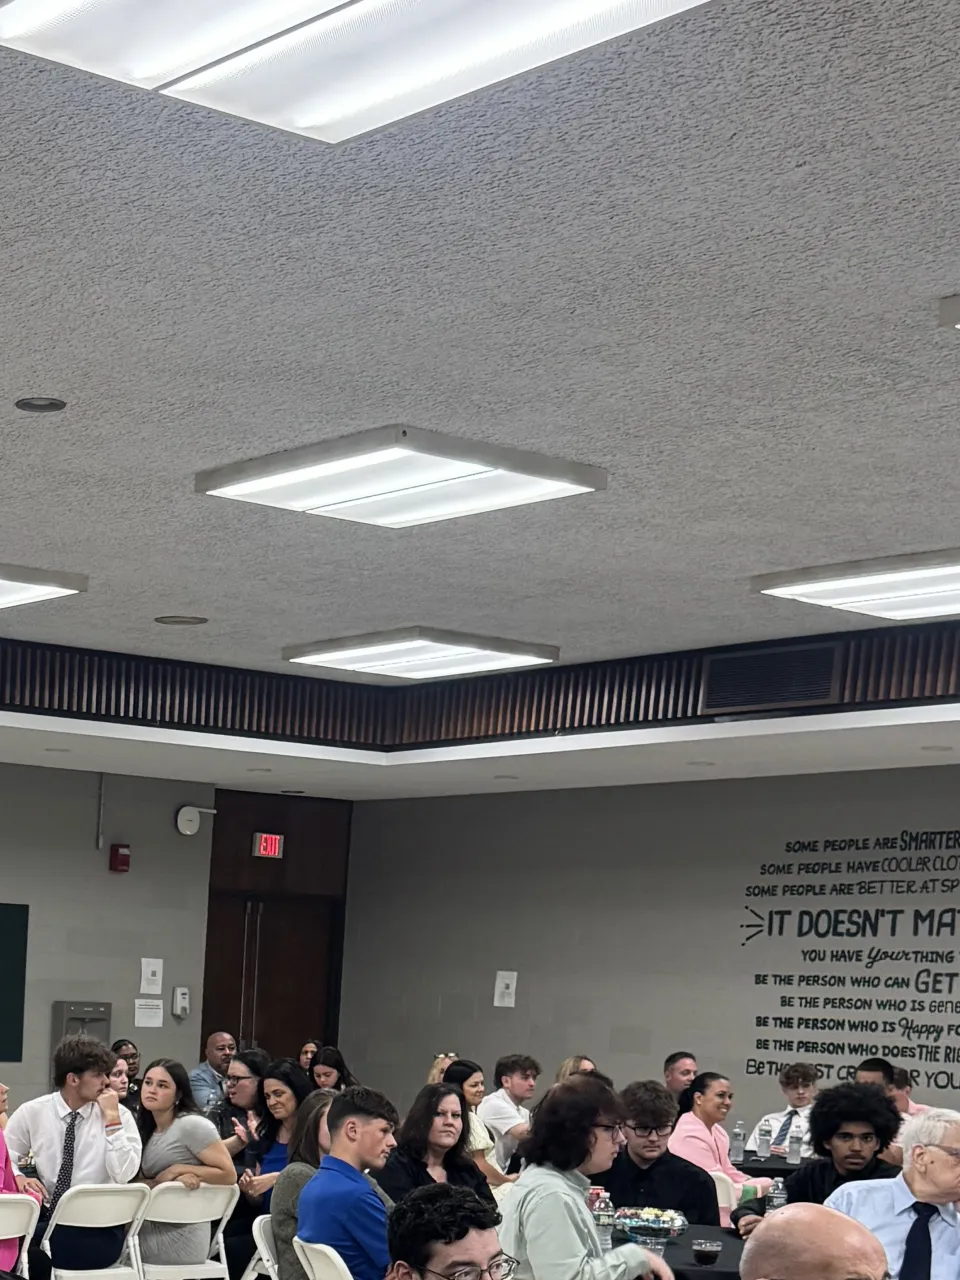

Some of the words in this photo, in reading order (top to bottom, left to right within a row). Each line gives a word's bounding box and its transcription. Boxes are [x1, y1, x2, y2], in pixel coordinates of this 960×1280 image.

[260, 833, 280, 856] EXIT
[785, 840, 819, 853] SOME
[824, 838, 870, 852] PEOPLE
[873, 836, 898, 850] ARE
[899, 830, 960, 851] SMARTER
[760, 862, 793, 875] SOME
[797, 861, 842, 875] PEOPLE
[847, 860, 880, 873] HAVE
[881, 856, 931, 873] COOLER
[933, 855, 960, 871] CLO
[745, 885, 778, 897] SOME
[782, 884, 826, 896] PEOPLE
[829, 883, 854, 895] ARE
[855, 880, 918, 895] BETTER
[919, 878, 941, 894] AT
[768, 909, 792, 936] IT
[797, 909, 904, 938] DOESN'T
[912, 908, 960, 937] MA
[801, 949, 826, 963] YOU
[830, 950, 863, 963] HAVE
[913, 950, 955, 964] THING
[754, 974, 768, 985] BE
[772, 974, 794, 986] THE
[797, 975, 846, 987] PERSON
[850, 976, 881, 988] WHO
[884, 976, 910, 989] CAN
[915, 968, 960, 994] GET
[780, 996, 794, 1007] BE
[798, 996, 820, 1008] THE
[823, 997, 873, 1010] PERSON
[876, 998, 907, 1012] WHO
[910, 1000, 926, 1012] IS
[755, 1016, 769, 1028] BE
[772, 1016, 794, 1029] THE
[797, 1017, 845, 1031] PERSON
[848, 1019, 879, 1033] WHO
[881, 1021, 896, 1033] IS
[898, 1017, 944, 1043] Happy
[756, 1039, 769, 1050] BE
[772, 1039, 794, 1052] THE
[797, 1040, 846, 1055] PERSON
[847, 1042, 879, 1056] WHO
[882, 1045, 916, 1058] DOES
[916, 1044, 941, 1063] THE
